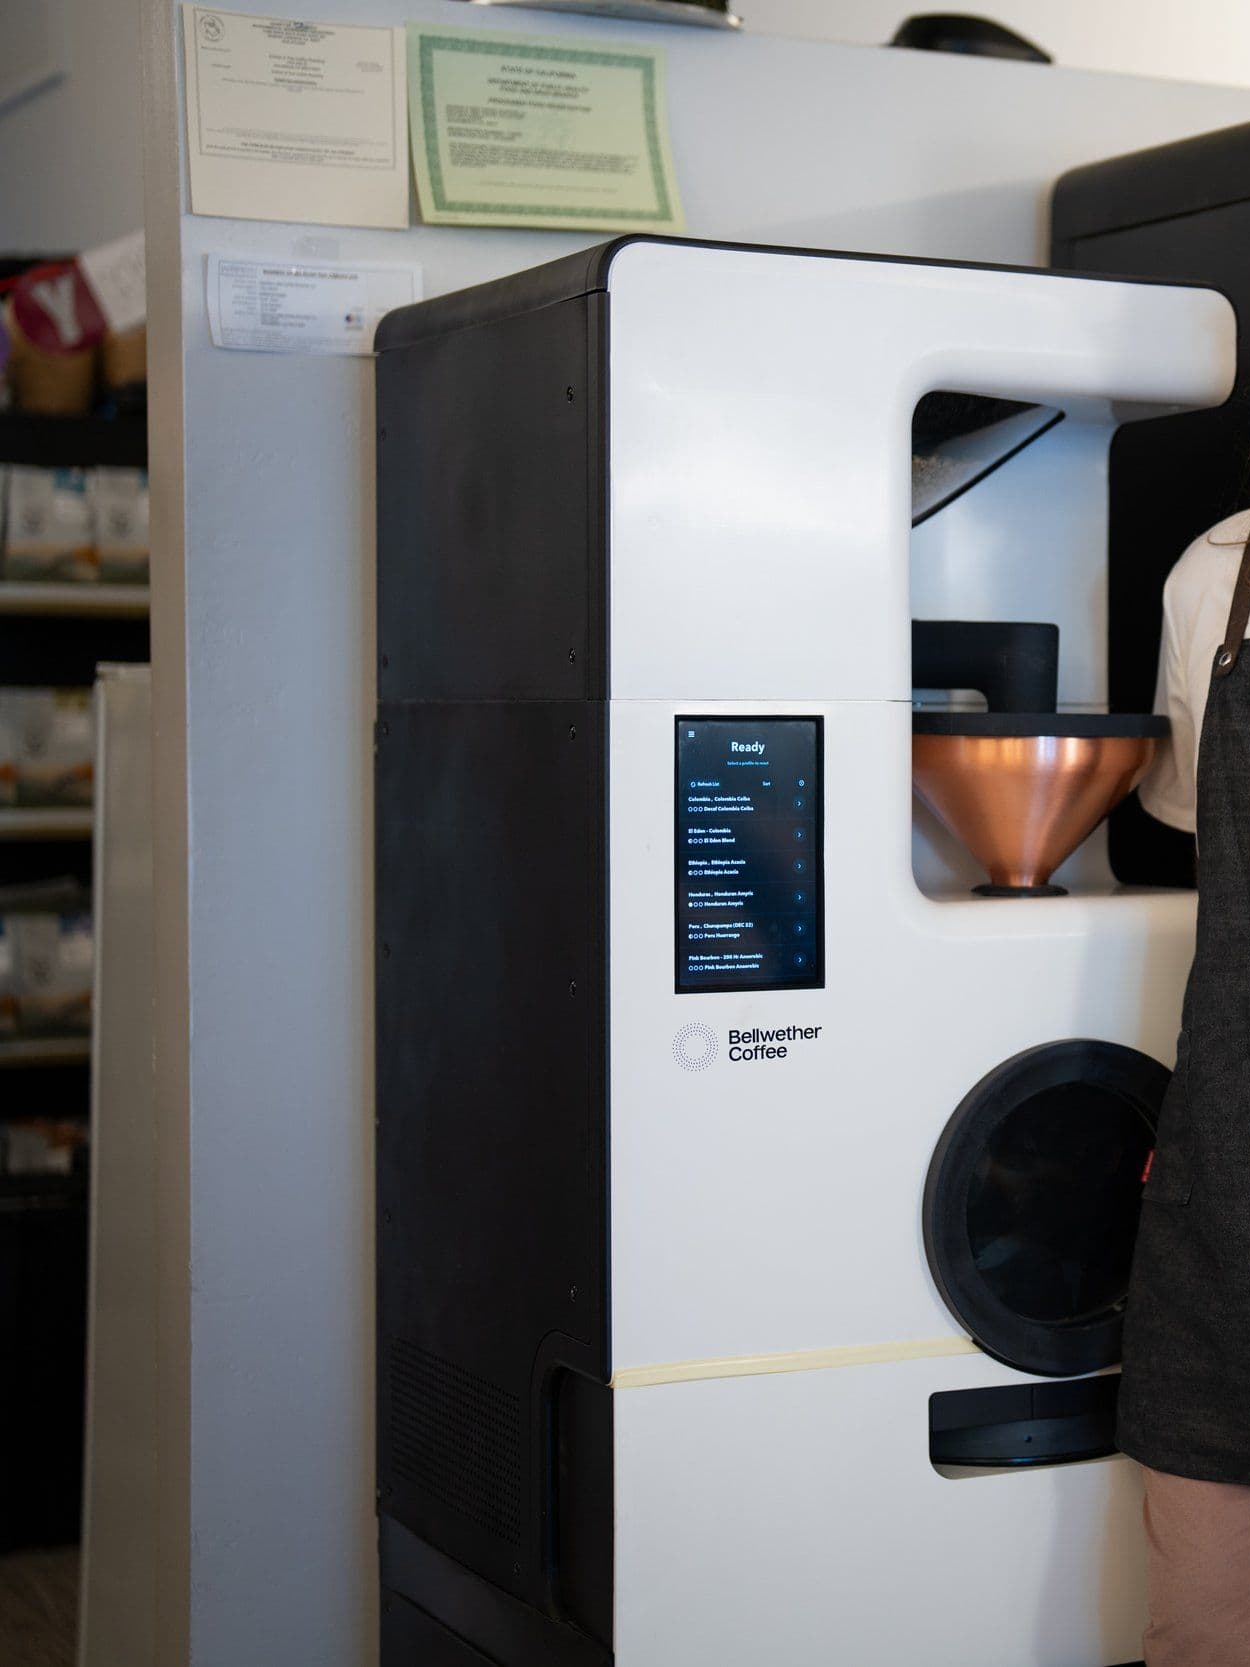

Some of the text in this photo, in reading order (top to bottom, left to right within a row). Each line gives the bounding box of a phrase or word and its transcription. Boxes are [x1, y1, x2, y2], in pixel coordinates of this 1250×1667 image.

[731, 741, 765, 755] Ready
[728, 1025, 822, 1045] Bellwether
[728, 1045, 788, 1062] Coffee
